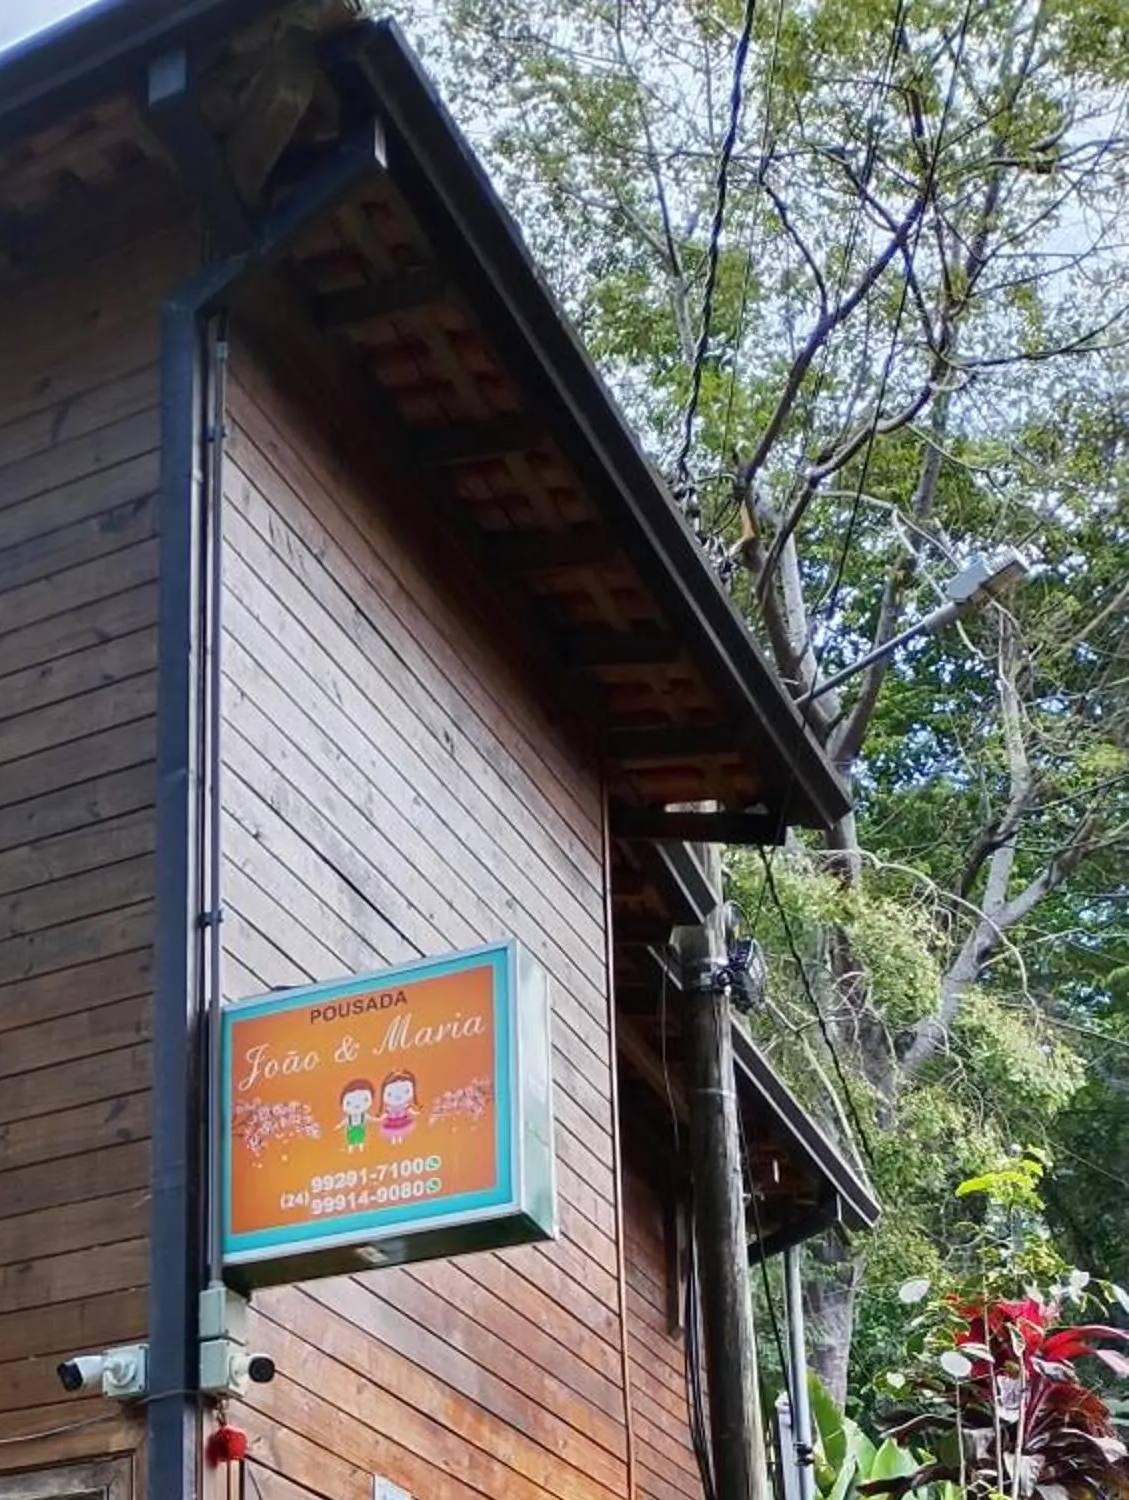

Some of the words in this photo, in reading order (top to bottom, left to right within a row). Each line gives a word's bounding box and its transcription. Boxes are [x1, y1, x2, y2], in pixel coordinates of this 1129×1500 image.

[309, 990, 408, 1025] POUSADA
[238, 1041, 321, 1092] João
[333, 1035, 360, 1064] &
[373, 1012, 486, 1056] Maria
[280, 1189, 310, 1210] (24)
